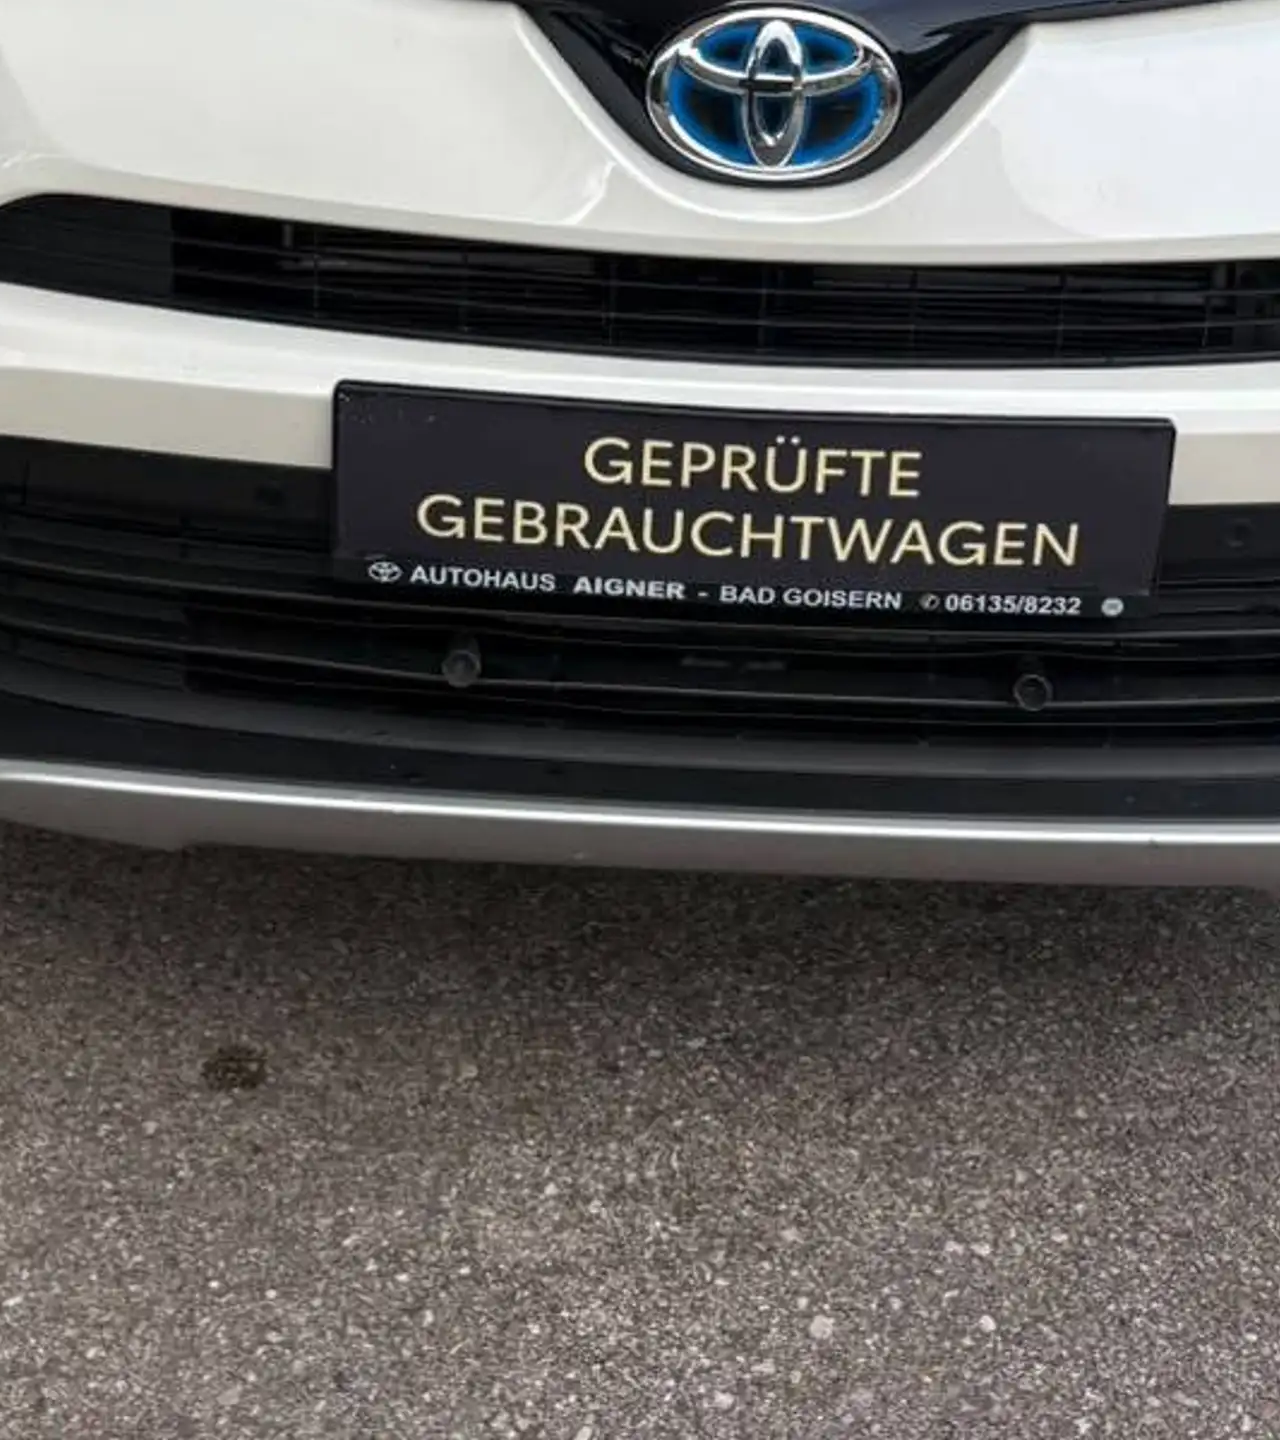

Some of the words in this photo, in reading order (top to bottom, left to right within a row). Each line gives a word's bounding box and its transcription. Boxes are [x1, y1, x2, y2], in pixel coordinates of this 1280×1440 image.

[584, 435, 922, 498] GEPRÜFTE
[416, 493, 1080, 567] GEBRAUCHTWAGEN
[409, 564, 557, 592] AUTOHAUS
[573, 575, 686, 601] AIGNER
[720, 585, 776, 606] BAD
[782, 587, 903, 610] GOISERN
[943, 593, 1083, 616] 06135/8232
